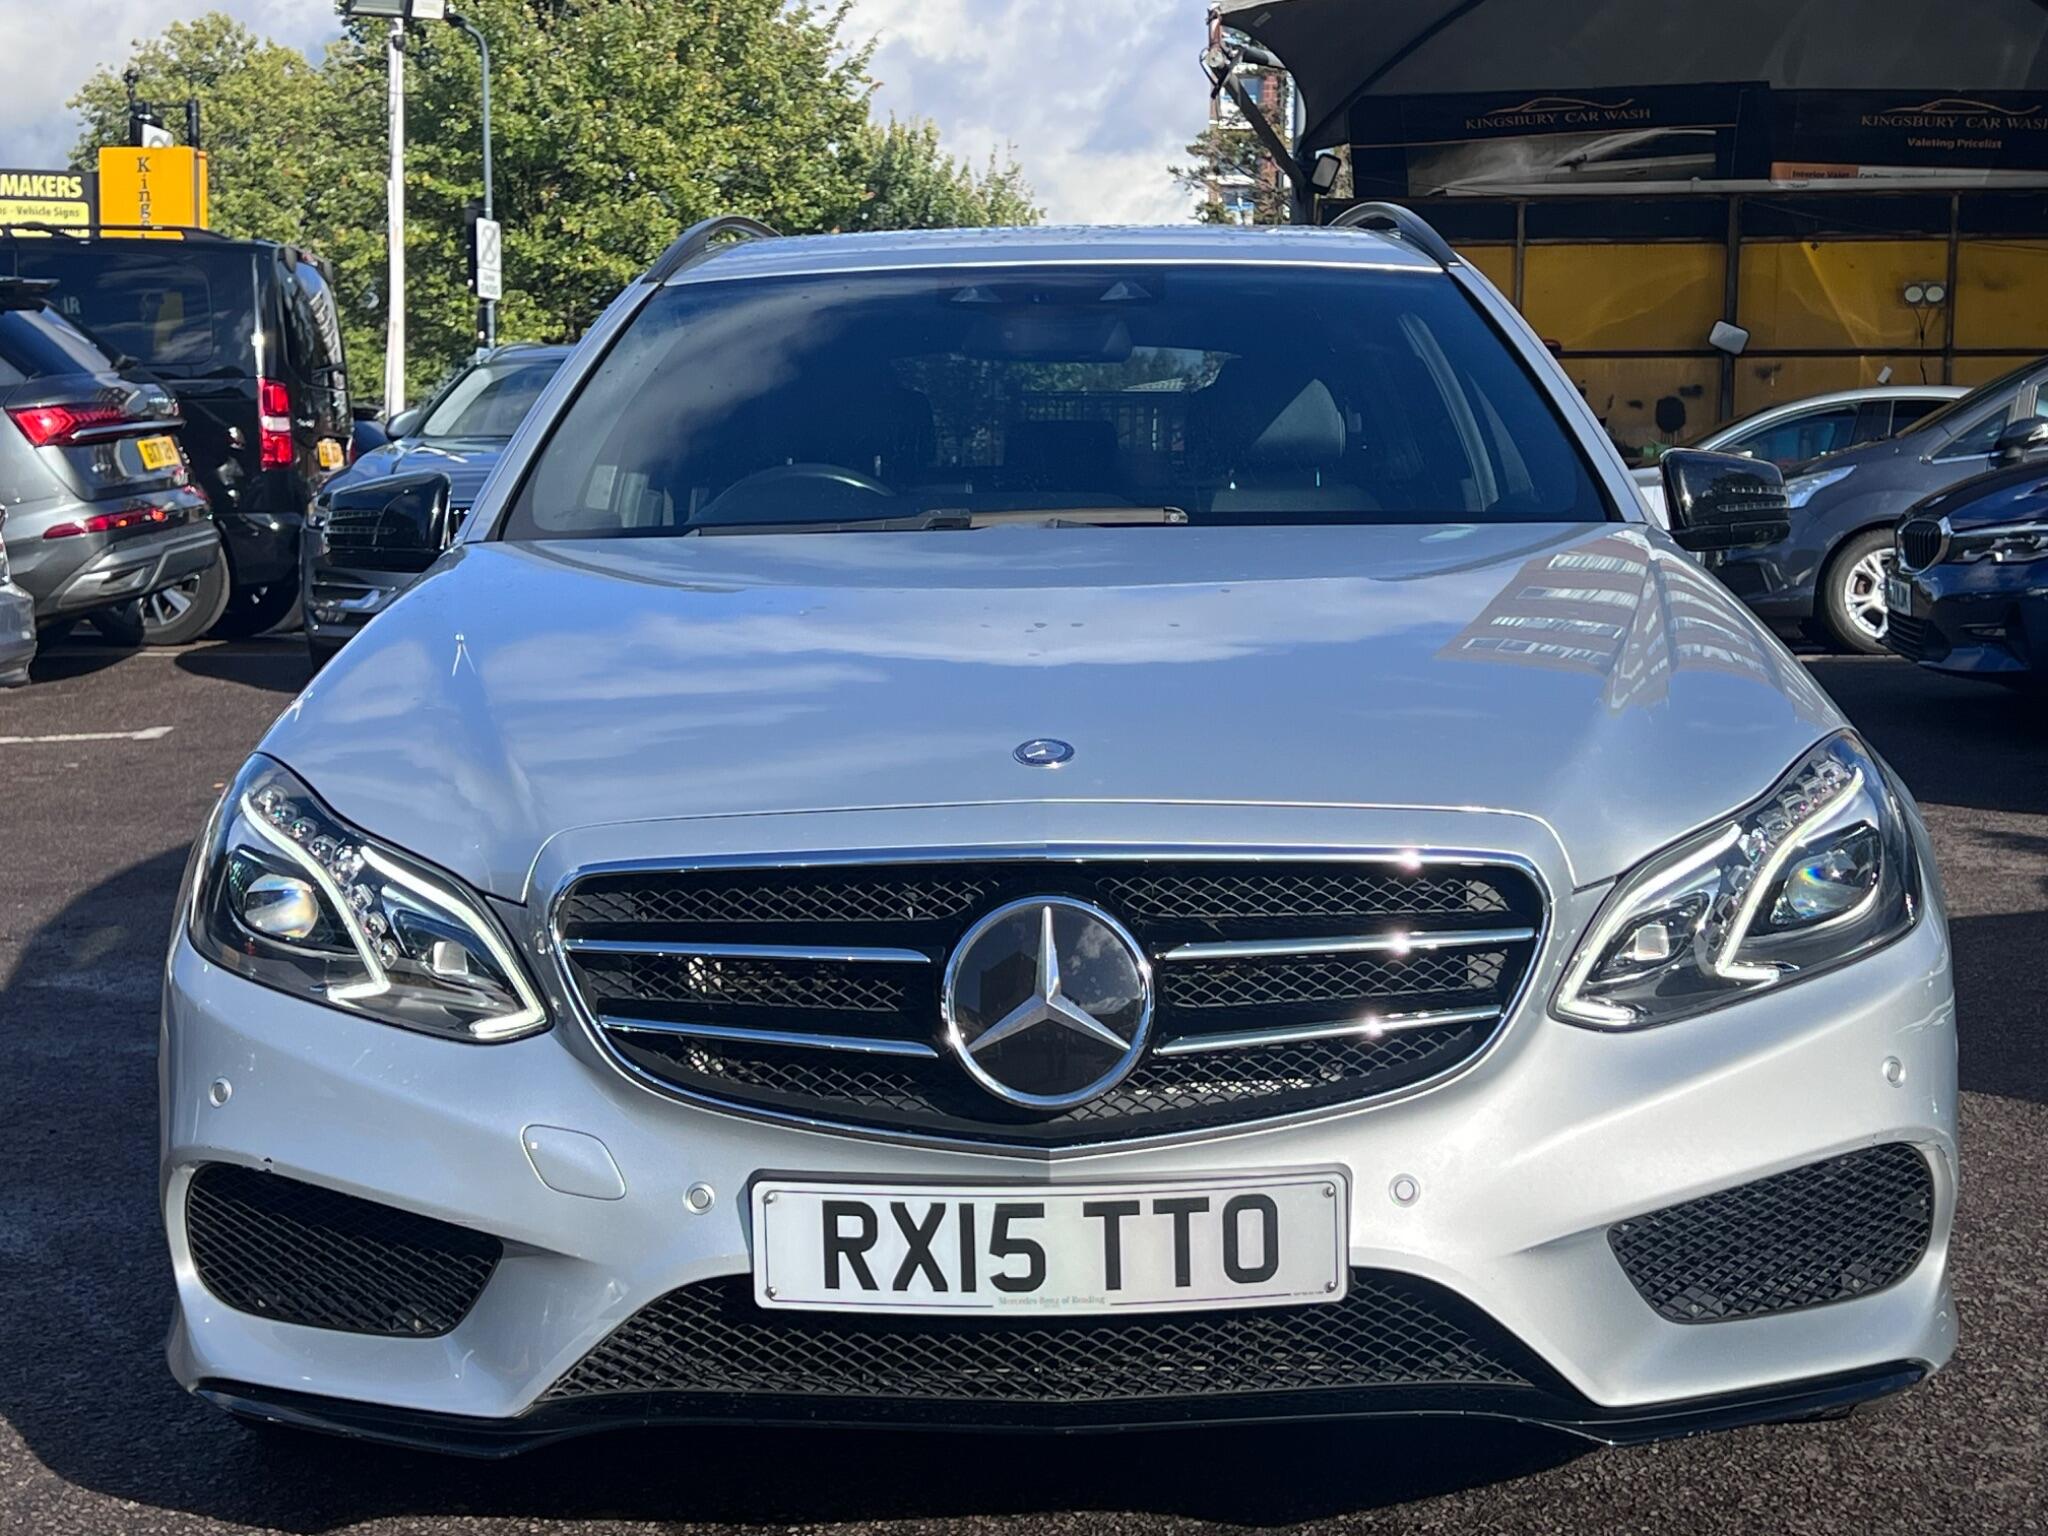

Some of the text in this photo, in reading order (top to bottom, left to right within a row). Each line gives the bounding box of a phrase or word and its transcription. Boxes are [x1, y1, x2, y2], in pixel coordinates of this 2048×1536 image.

[1465, 108, 1651, 130] KINGSBURY CAR WASH
[1860, 115, 1959, 129] KINGSBURY
[1965, 116, 2001, 129] CAR
[1907, 137, 1955, 150] Valeting
[0, 173, 83, 198] MAKERS
[16, 205, 51, 216] Vehicle
[53, 206, 80, 219] Signs
[821, 1193, 1279, 1293] RX15 TTO
